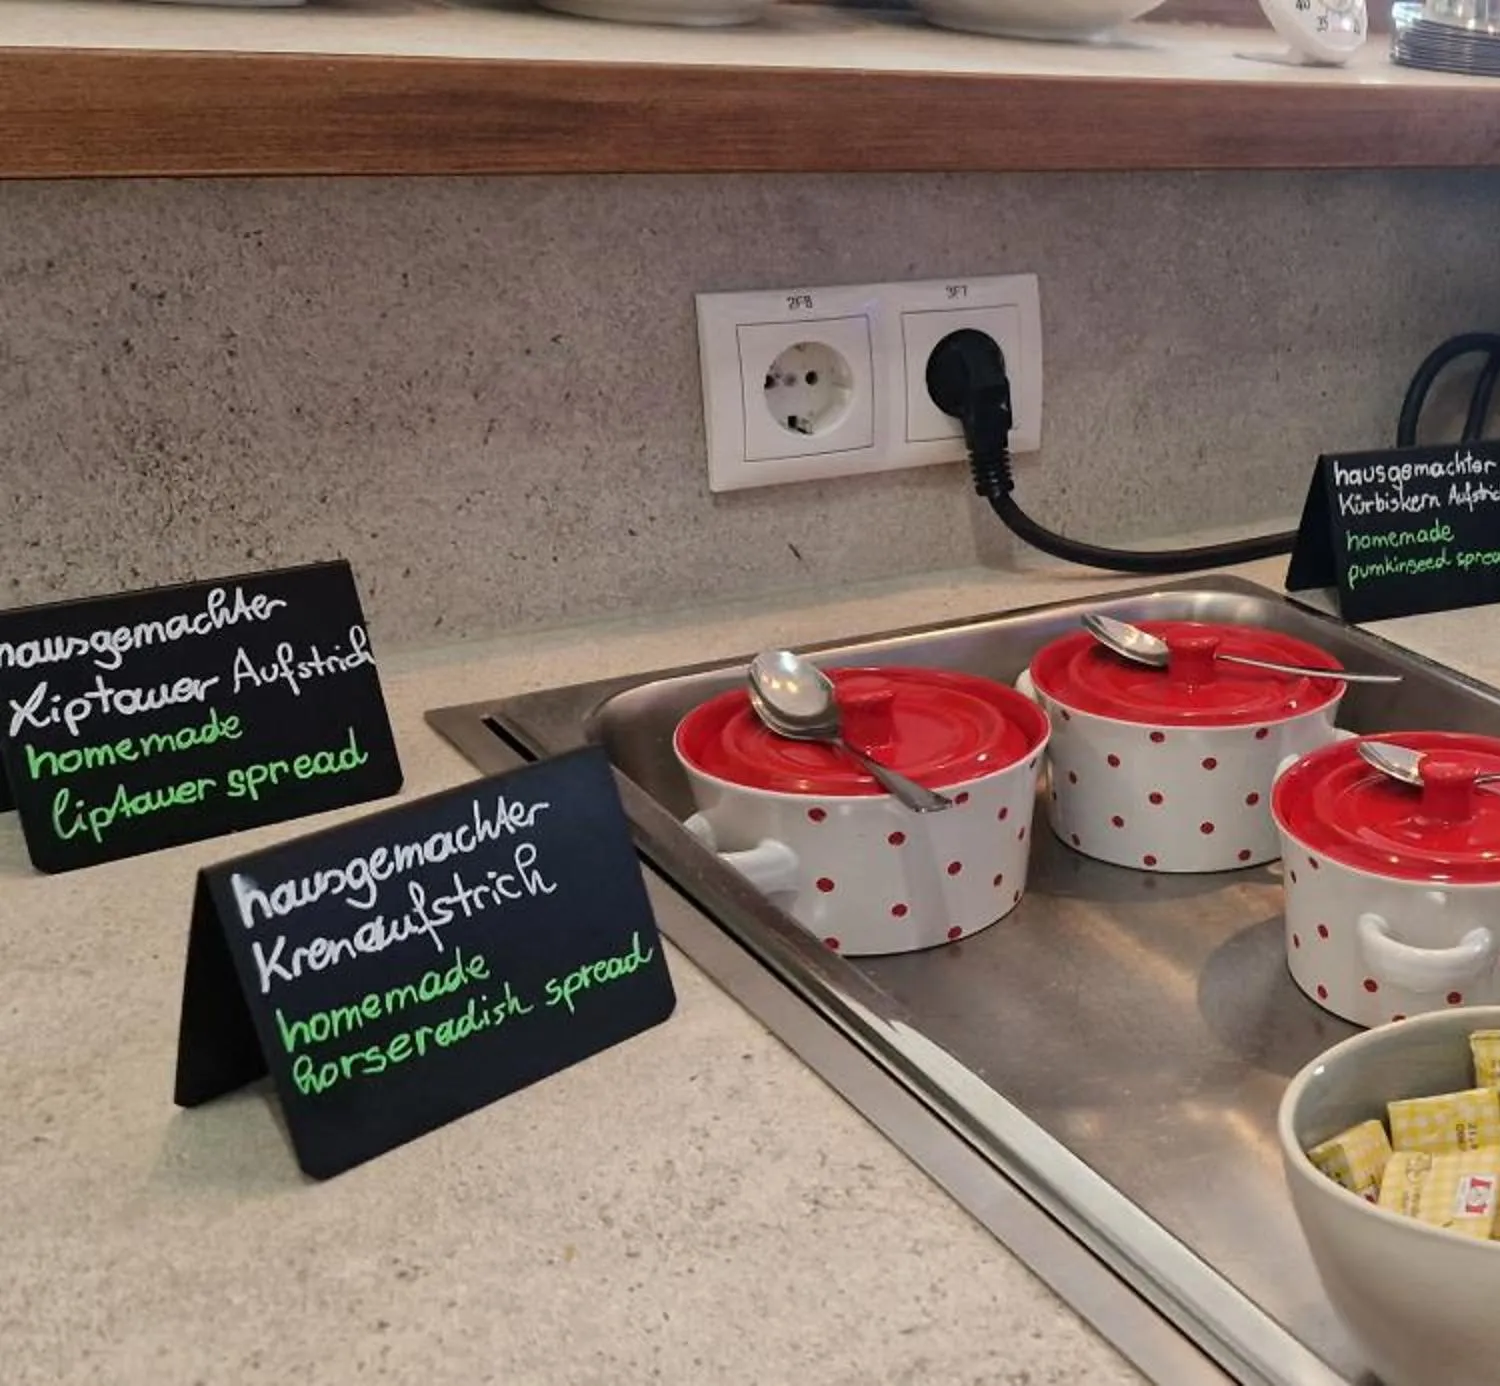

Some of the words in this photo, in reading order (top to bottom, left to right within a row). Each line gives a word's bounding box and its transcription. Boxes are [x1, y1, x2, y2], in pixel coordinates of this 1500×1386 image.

[1333, 450, 1498, 491] hausgemachter
[1346, 518, 1456, 552] homemade
[1347, 548, 1451, 590] pumkinseed
[25, 706, 244, 780] homemade
[51, 783, 219, 843] liptauer
[226, 727, 370, 801] spread
[230, 795, 551, 930] hausgemachter
[251, 842, 558, 995] Krenaufstrich
[275, 946, 491, 1054] homemade
[291, 982, 534, 1096] horseradish
[544, 931, 654, 1014] spread
